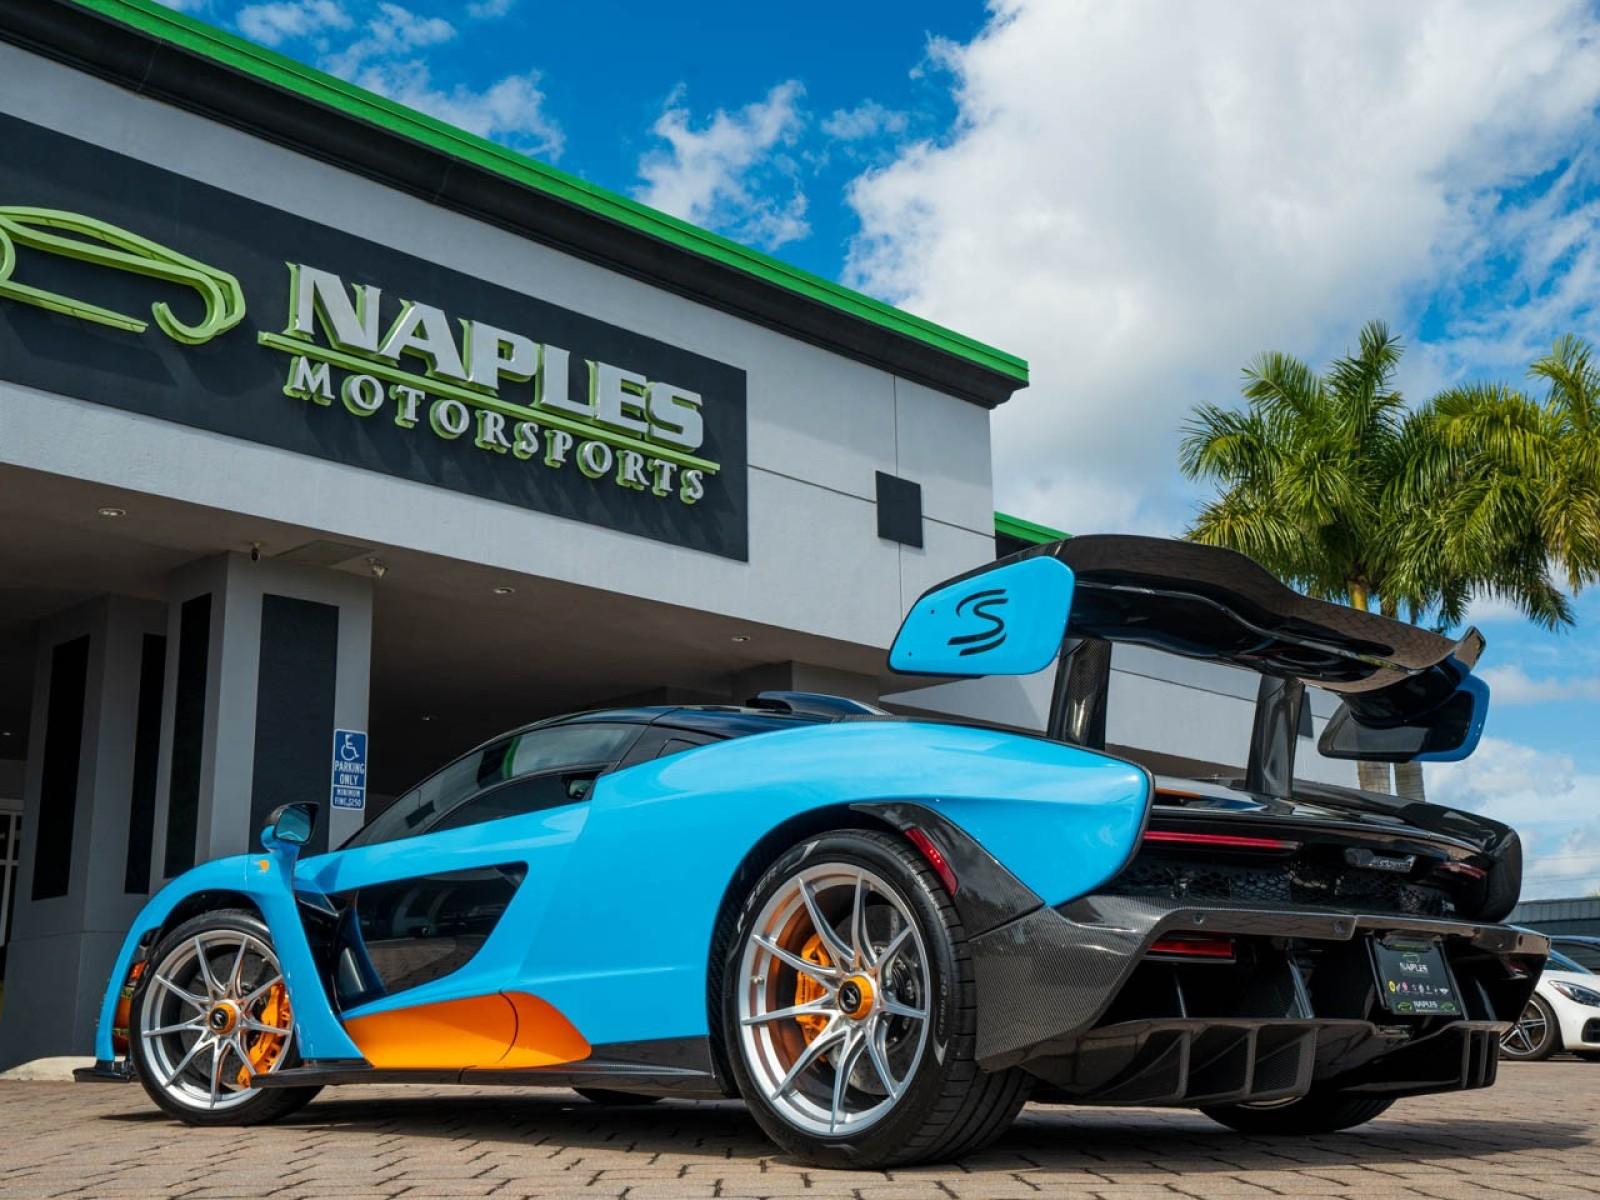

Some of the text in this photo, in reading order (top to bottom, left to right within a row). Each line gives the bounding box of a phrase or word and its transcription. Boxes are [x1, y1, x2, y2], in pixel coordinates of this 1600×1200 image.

[285, 261, 703, 453] NAPLES
[283, 356, 704, 504] MOTORSPORTS
[334, 760, 364, 774] PARKING
[340, 773, 358, 785] ONLY
[1400, 962, 1429, 973] NAPLES
